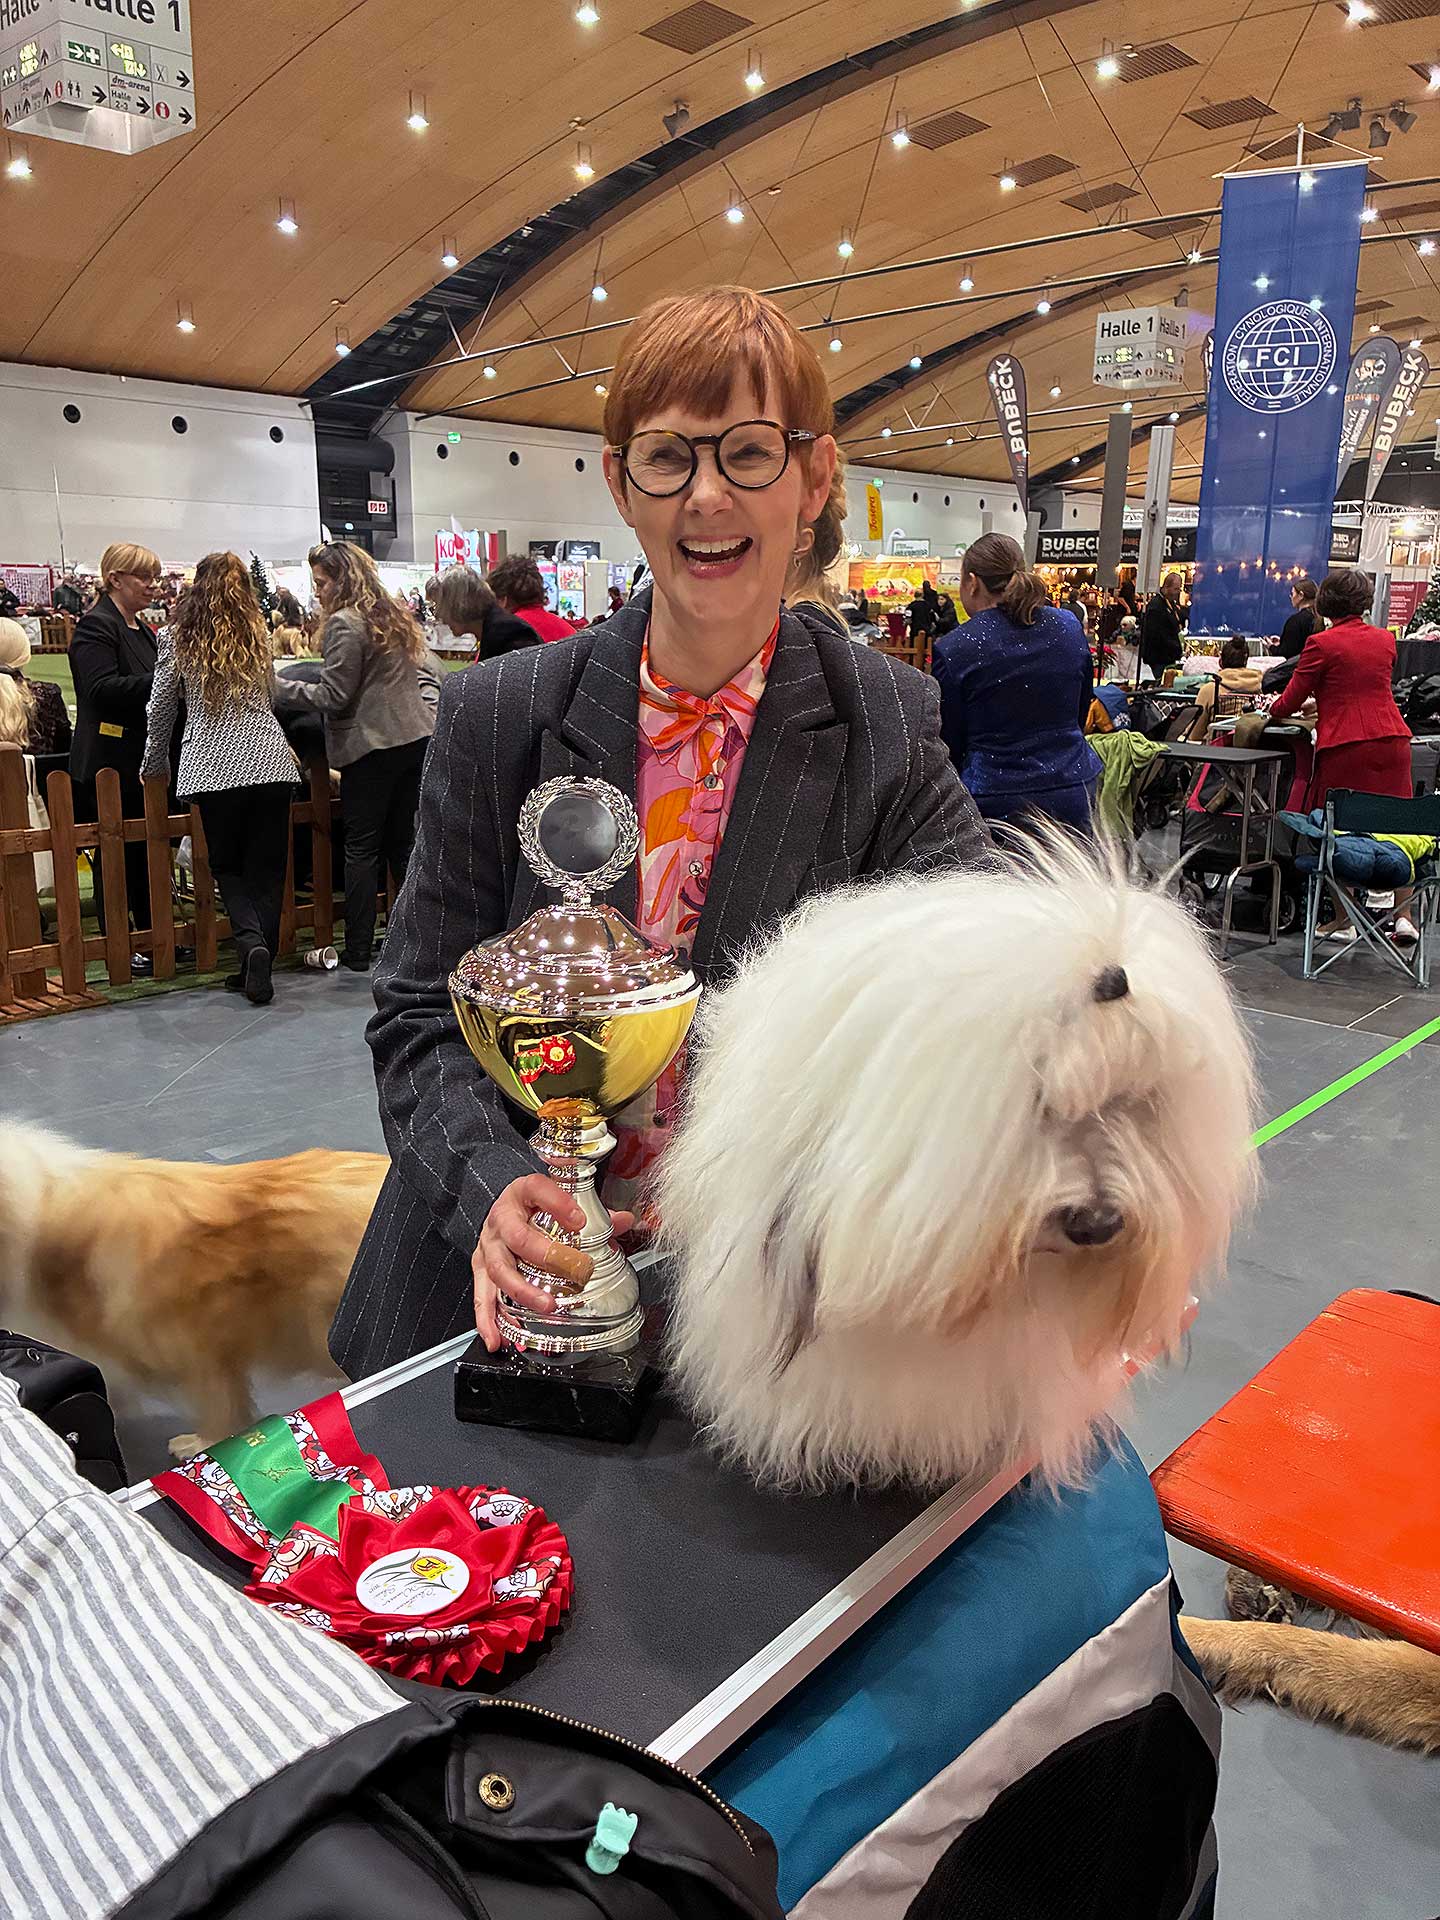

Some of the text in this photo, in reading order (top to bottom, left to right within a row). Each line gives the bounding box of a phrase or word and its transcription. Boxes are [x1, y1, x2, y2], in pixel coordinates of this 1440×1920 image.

[168, 0, 181, 32] 1
[111, 75, 151, 92] dm-arena
[1100, 316, 1153, 338] Halle 1
[1160, 317, 1185, 340] Halle 1
[1235, 304, 1311, 340] CYNOLOGIQUE
[1292, 318, 1332, 405] INTERNATIONALE
[1256, 346, 1300, 367] FCI
[1374, 353, 1423, 451] BUBECK
[869, 496, 878, 531] Josera
[440, 538, 470, 558] KOG
